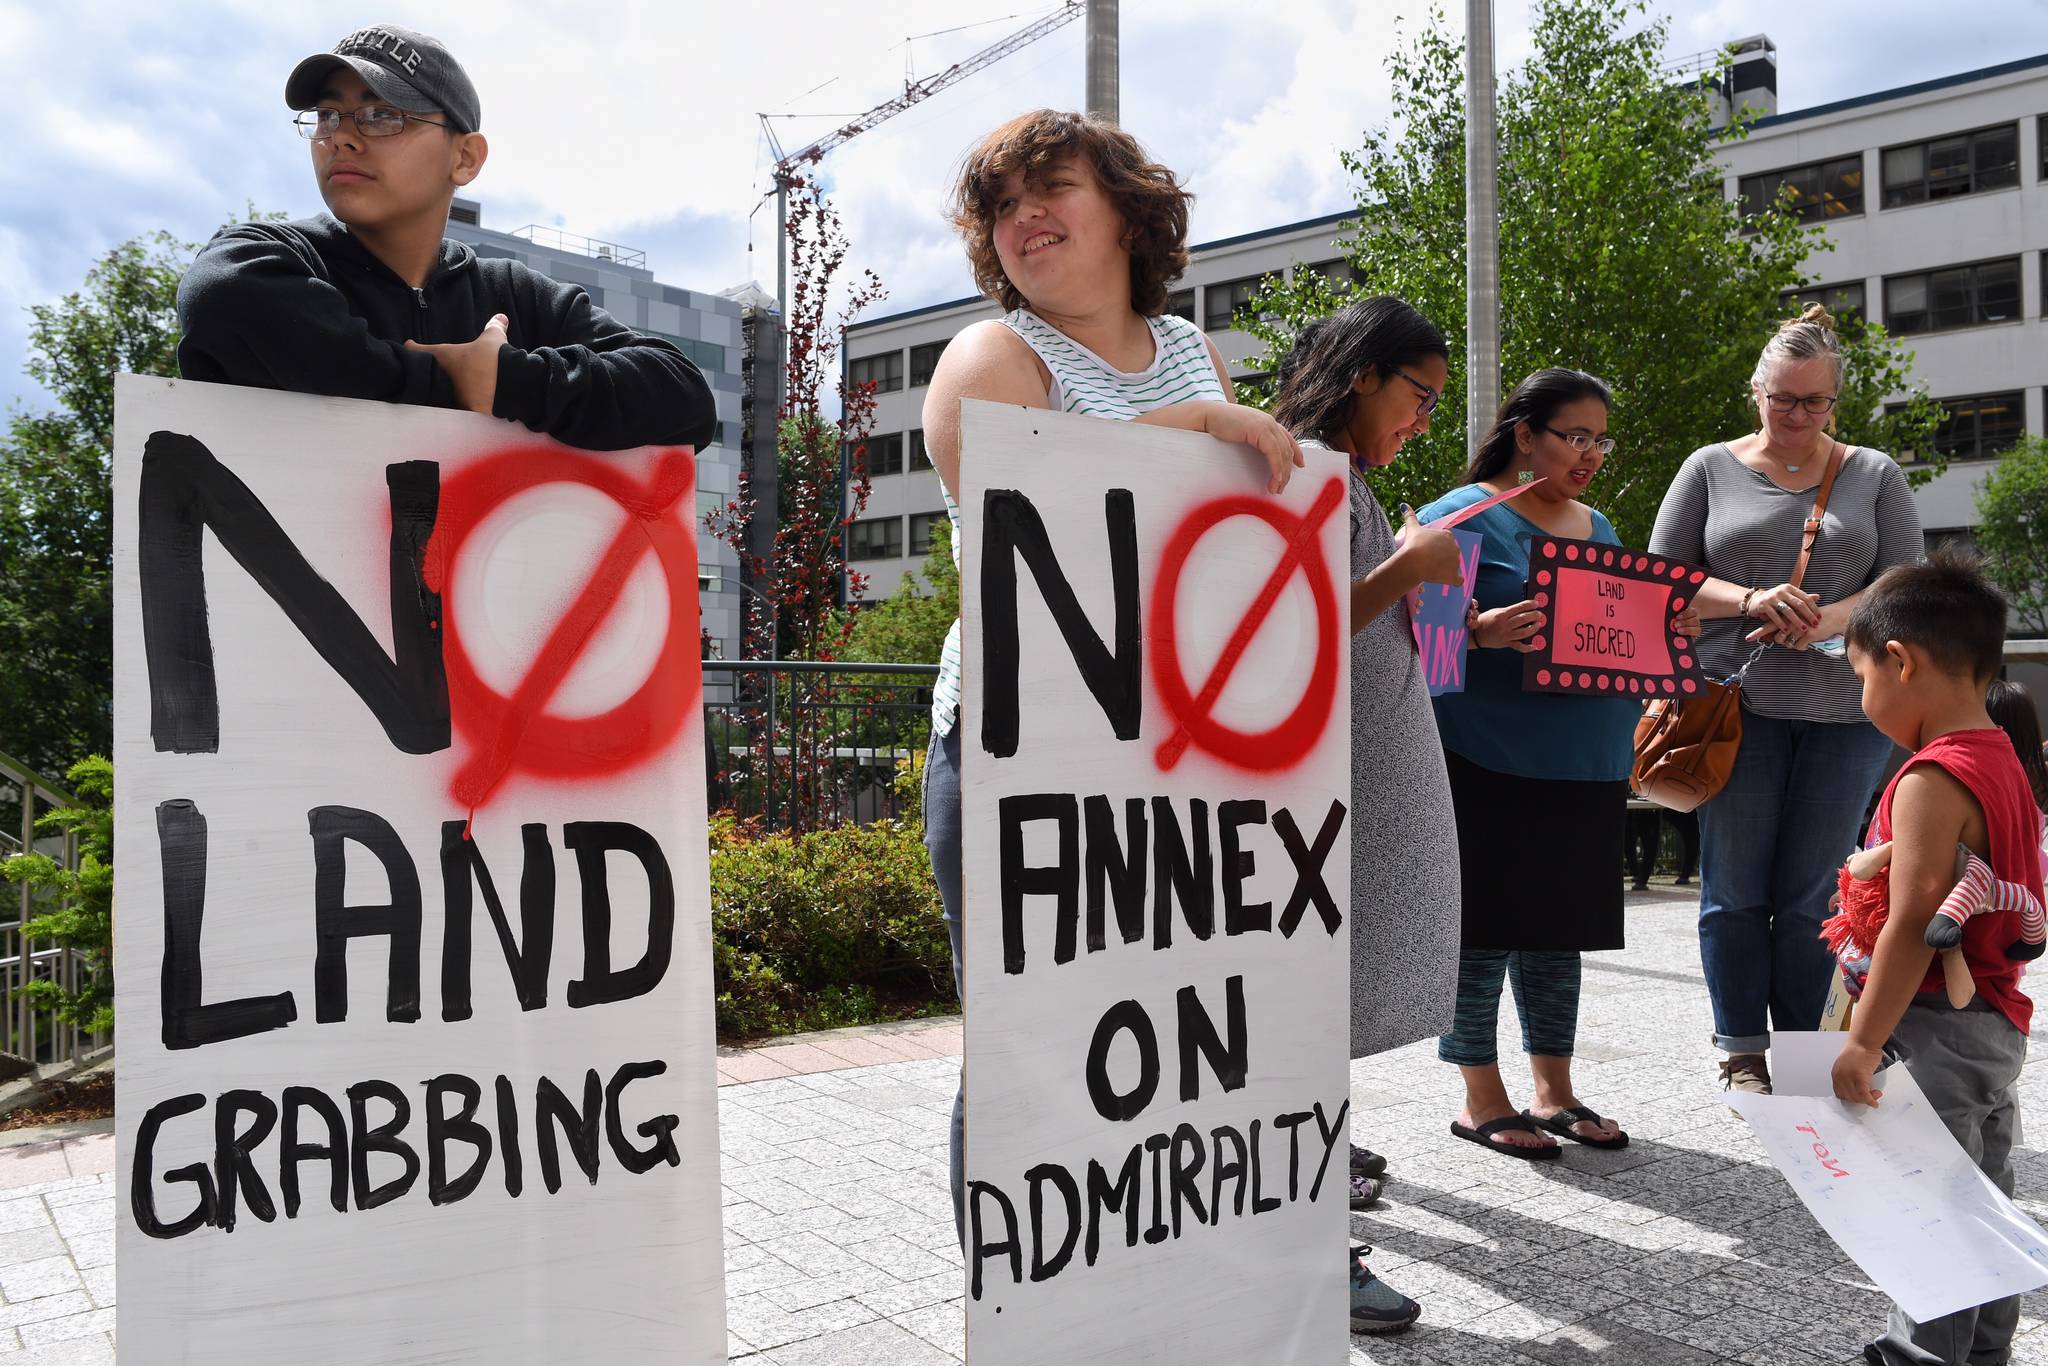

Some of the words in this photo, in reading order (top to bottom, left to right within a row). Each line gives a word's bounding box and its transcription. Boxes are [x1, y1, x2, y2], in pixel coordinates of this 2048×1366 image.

[1574, 621, 1636, 659] SACRED
[1597, 579, 1625, 600] LAND
[1605, 604, 1615, 618] IS
[156, 798, 674, 1050] LAND
[999, 793, 1347, 976] ANNEX
[1086, 975, 1248, 1122] ON
[131, 1059, 681, 1240] GRABBING
[966, 1098, 1349, 1302] ADMIRALTY
